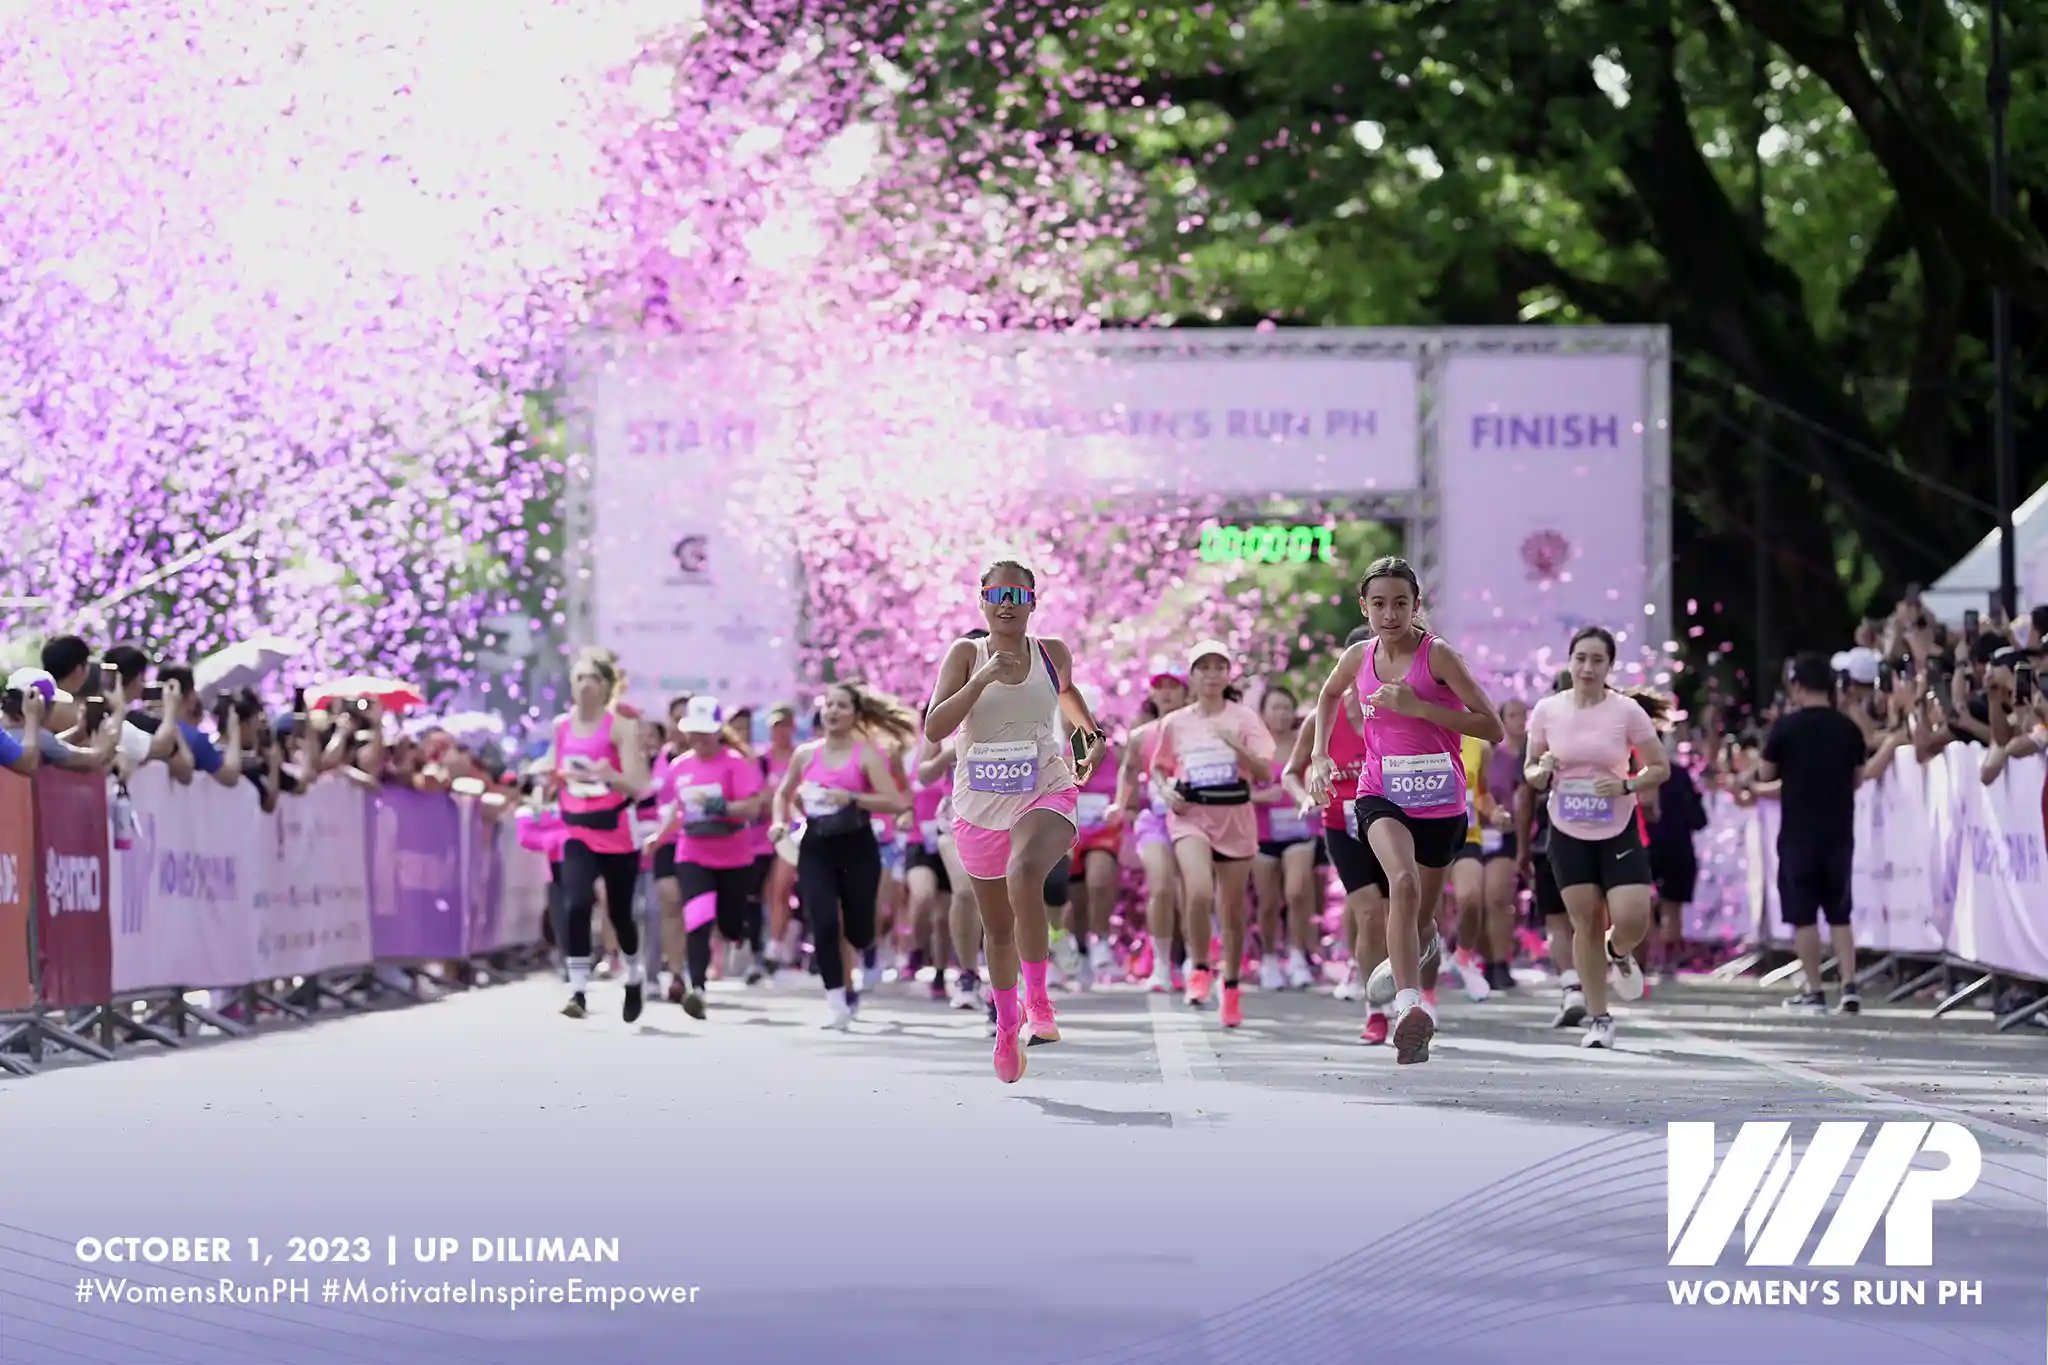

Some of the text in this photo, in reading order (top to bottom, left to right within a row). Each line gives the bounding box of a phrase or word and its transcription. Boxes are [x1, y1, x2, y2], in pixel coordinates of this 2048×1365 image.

[1226, 409, 1311, 438] RUN
[1325, 409, 1379, 437] PH
[1472, 413, 1619, 449] FINISH
[975, 762, 1033, 780] 50260
[1390, 774, 1449, 793] 50867
[1563, 796, 1608, 811] 50476
